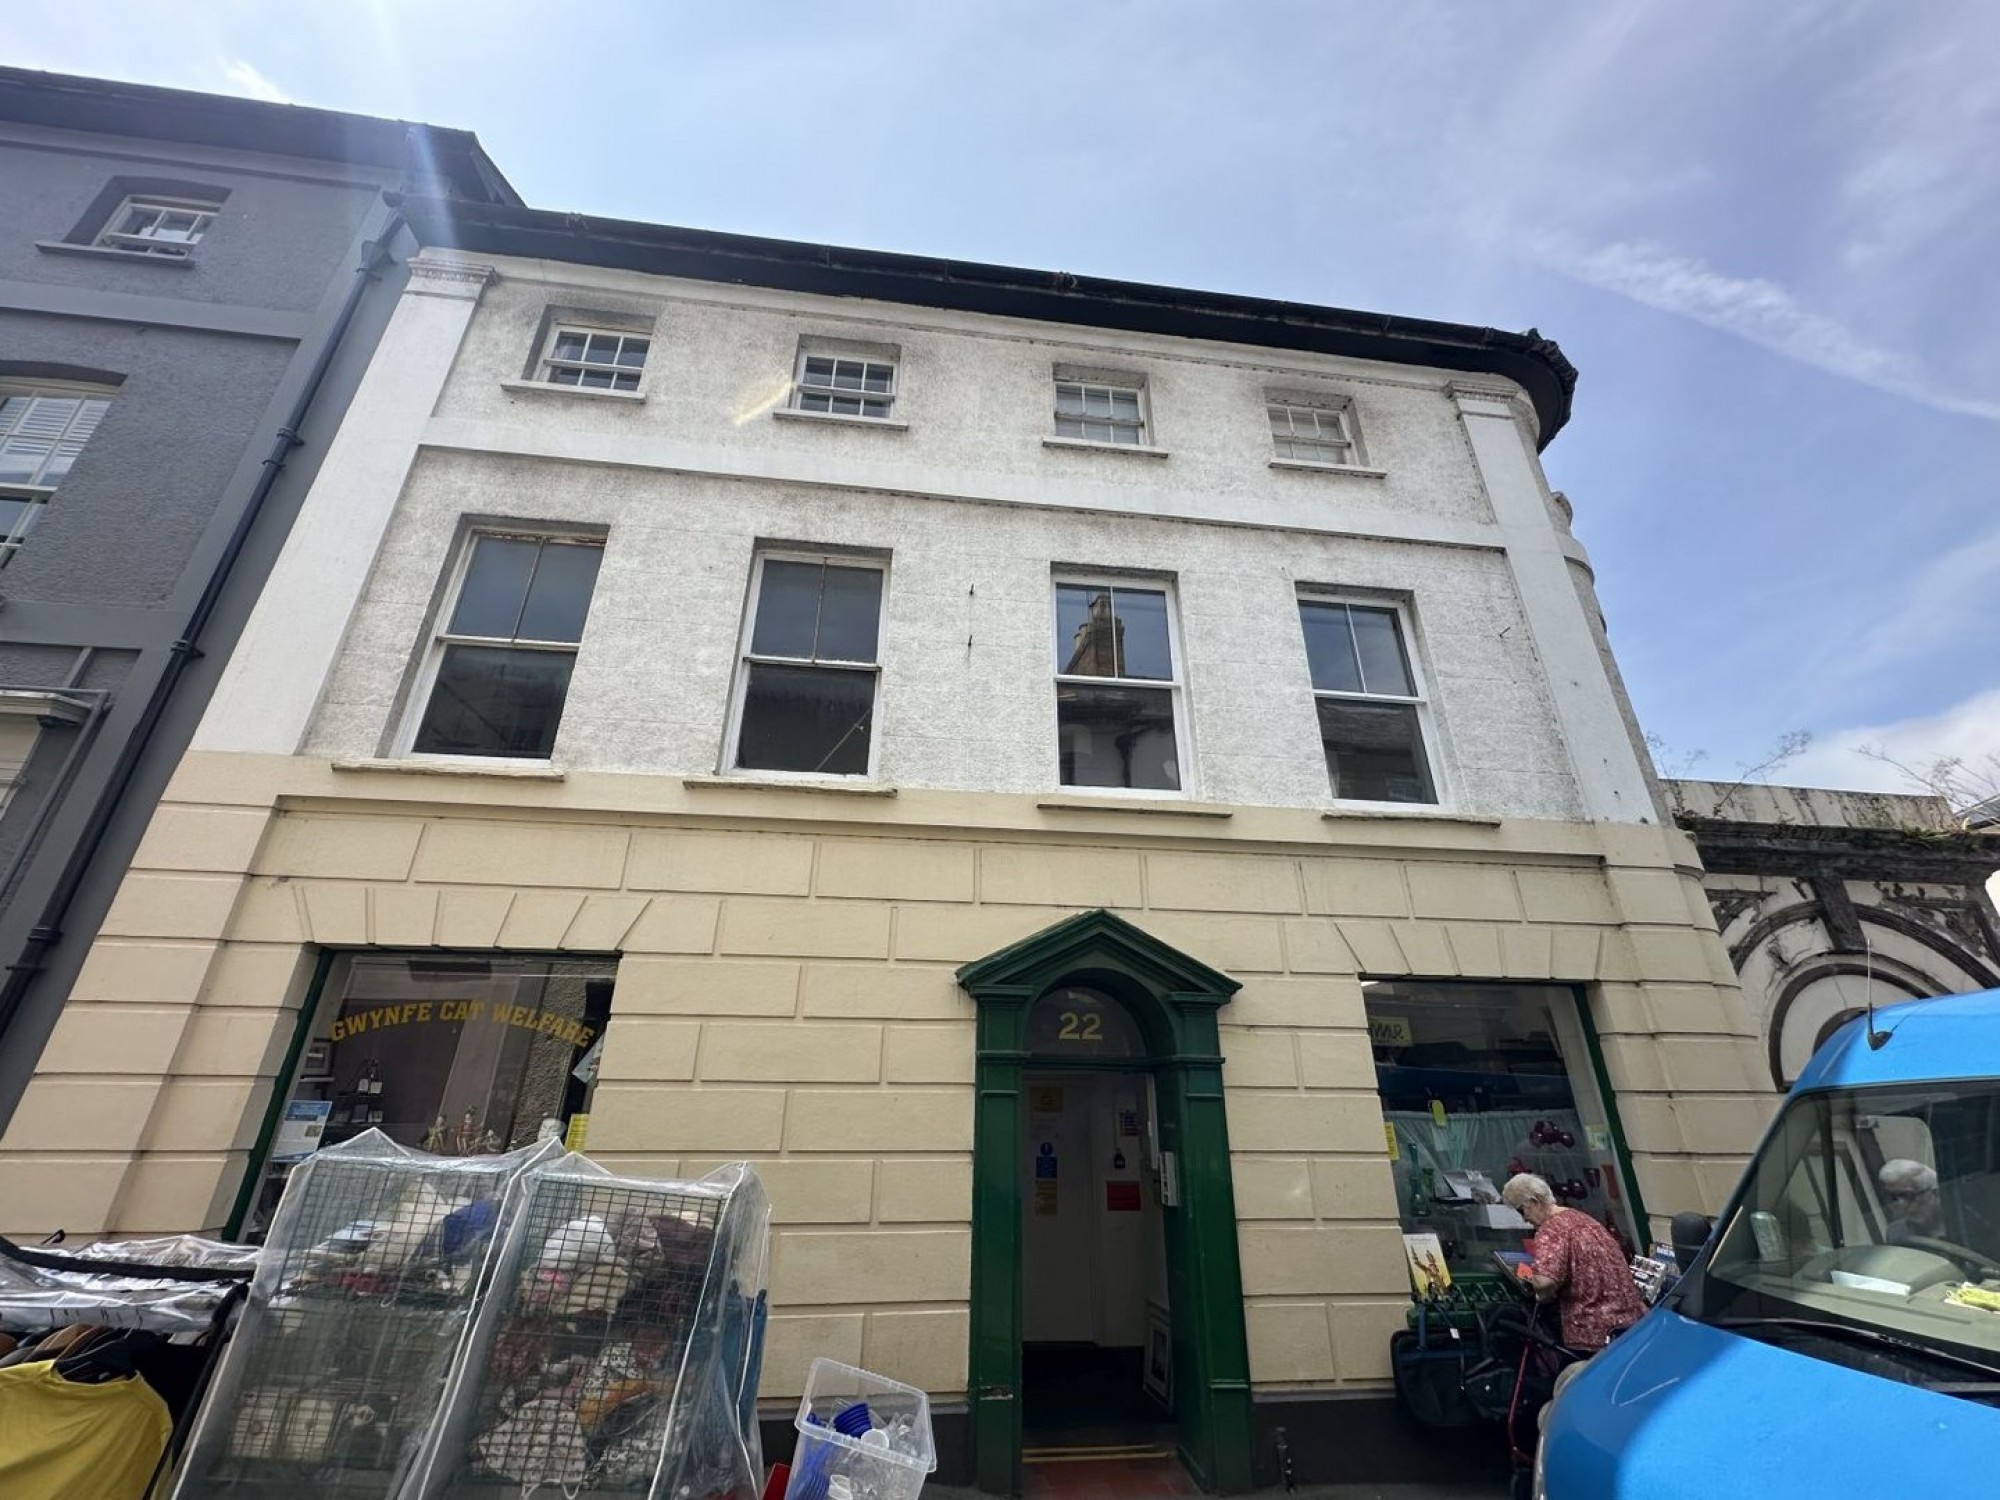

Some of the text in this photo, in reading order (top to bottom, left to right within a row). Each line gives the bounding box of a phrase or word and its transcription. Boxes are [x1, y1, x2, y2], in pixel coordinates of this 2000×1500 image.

[331, 1001, 595, 1047] GWYNFE CAT WELFARE
[1058, 1011, 1103, 1040] 22
